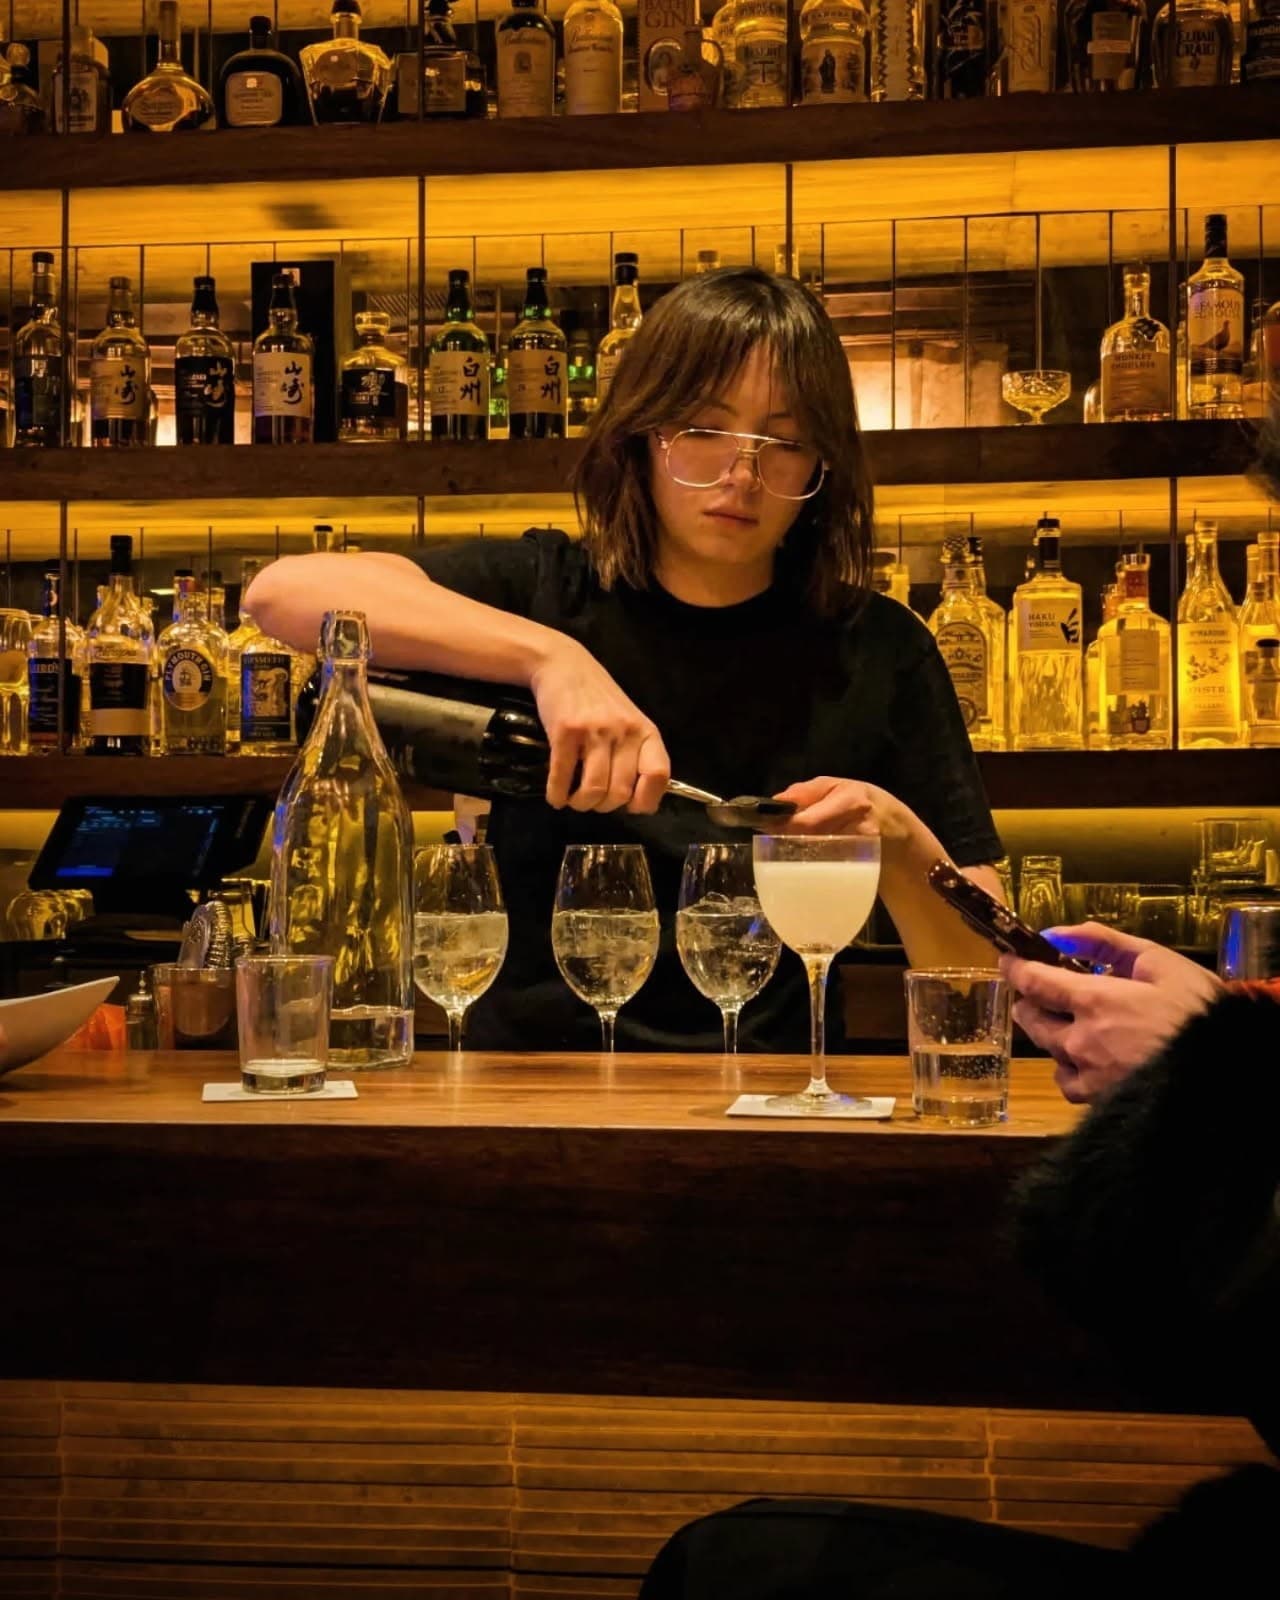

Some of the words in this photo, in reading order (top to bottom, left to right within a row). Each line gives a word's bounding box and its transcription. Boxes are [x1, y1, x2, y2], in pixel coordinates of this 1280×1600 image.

[645, 11, 687, 27] GIN
[1176, 43, 1217, 56] CRAIG
[280, 361, 305, 405] 山崎
[459, 356, 481, 406] 白州
[540, 354, 561, 405] 白州
[1029, 613, 1056, 621] HAKU
[165, 651, 204, 681] PLYMOUTH
[200, 663, 212, 681] GIN
